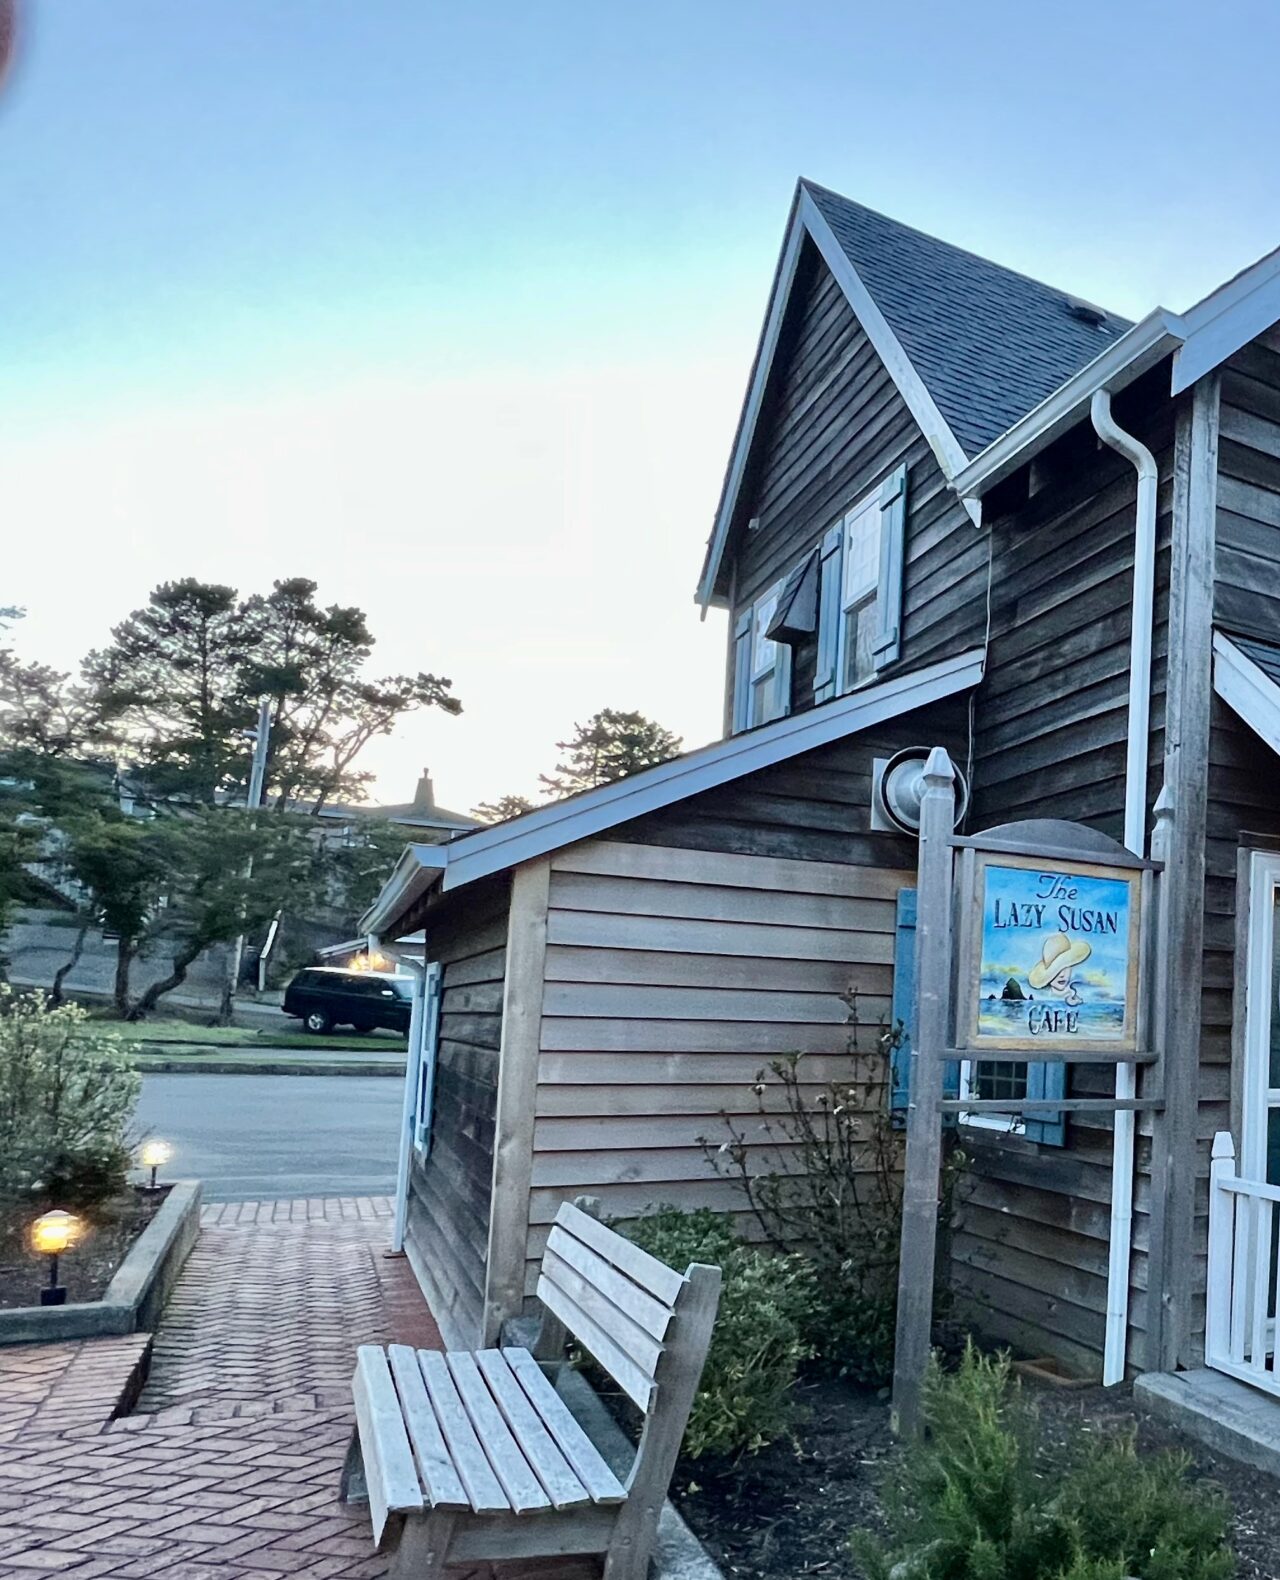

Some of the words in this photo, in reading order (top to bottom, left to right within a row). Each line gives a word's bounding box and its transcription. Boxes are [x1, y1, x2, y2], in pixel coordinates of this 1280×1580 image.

[1036, 874, 1078, 900] The
[993, 898, 1047, 929] LAZY
[1058, 904, 1118, 934] SUSAN
[1028, 1005, 1079, 1035] CAFE
